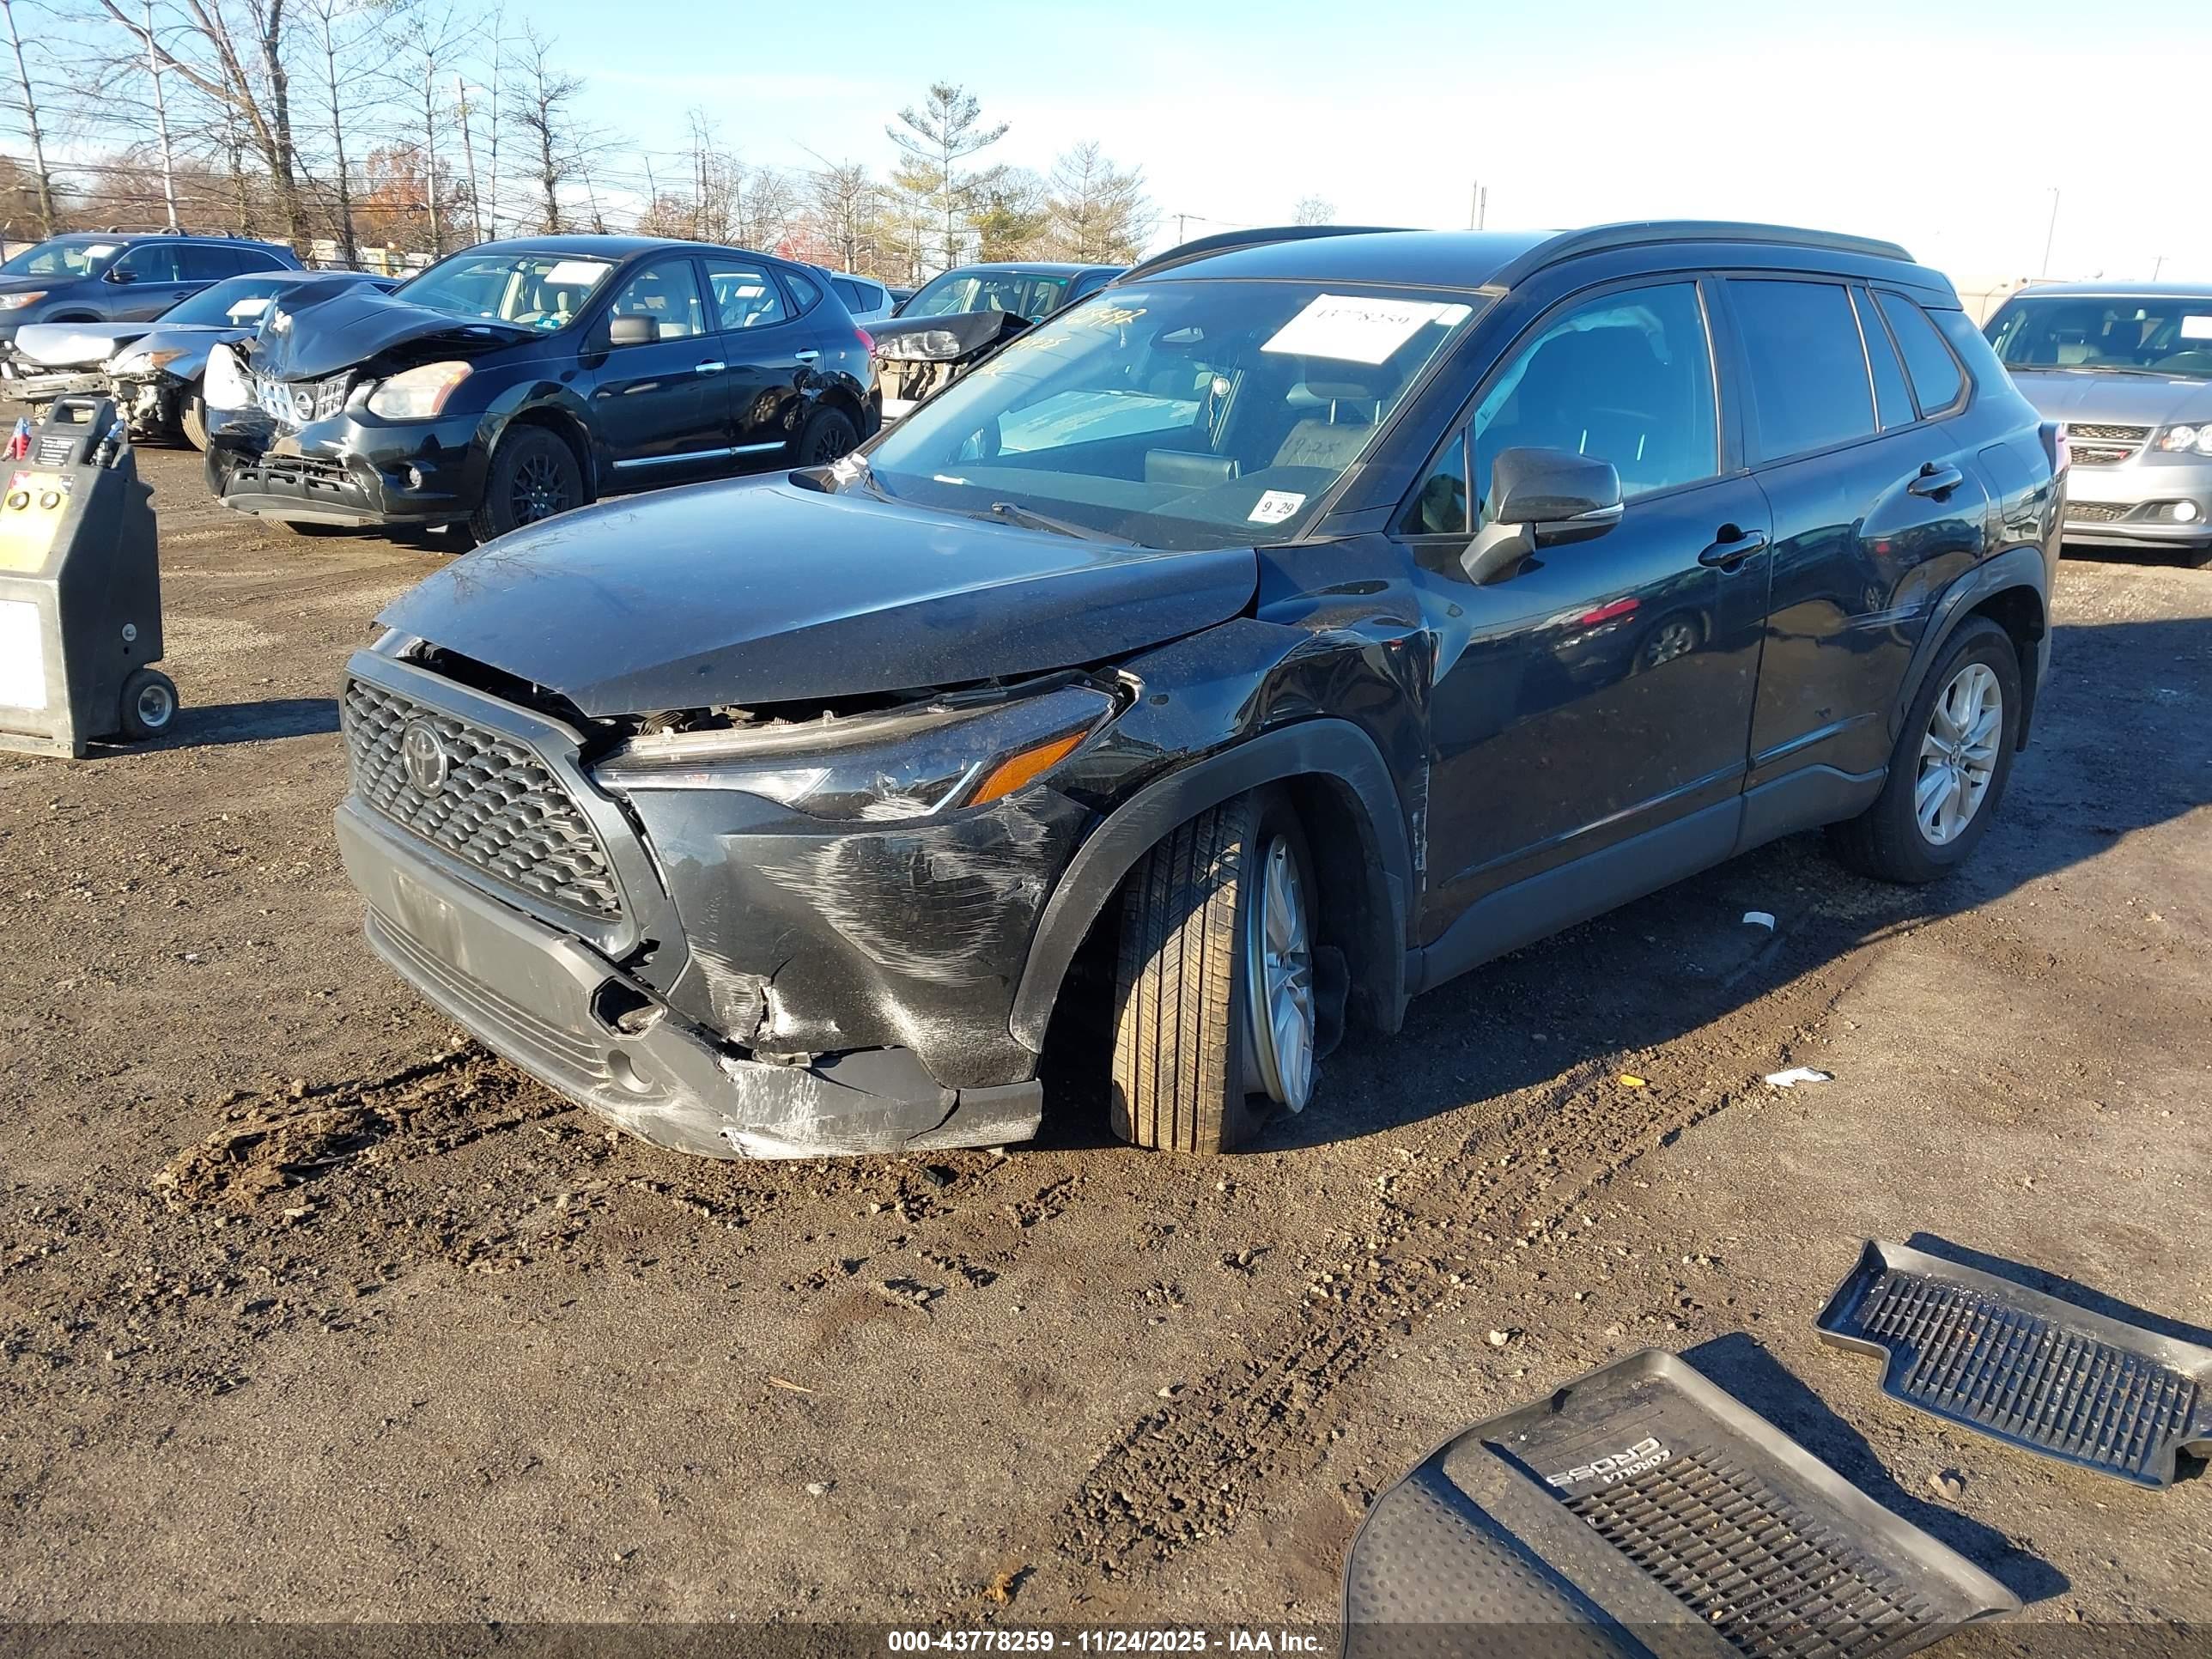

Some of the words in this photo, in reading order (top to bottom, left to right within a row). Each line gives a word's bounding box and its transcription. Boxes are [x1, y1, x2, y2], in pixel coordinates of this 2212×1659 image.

[1261, 501, 1272, 513] 9
[1276, 501, 1295, 514] 29
[1547, 1437, 1662, 1487] CROSS
[1602, 1449, 1672, 1484] COROLLA
